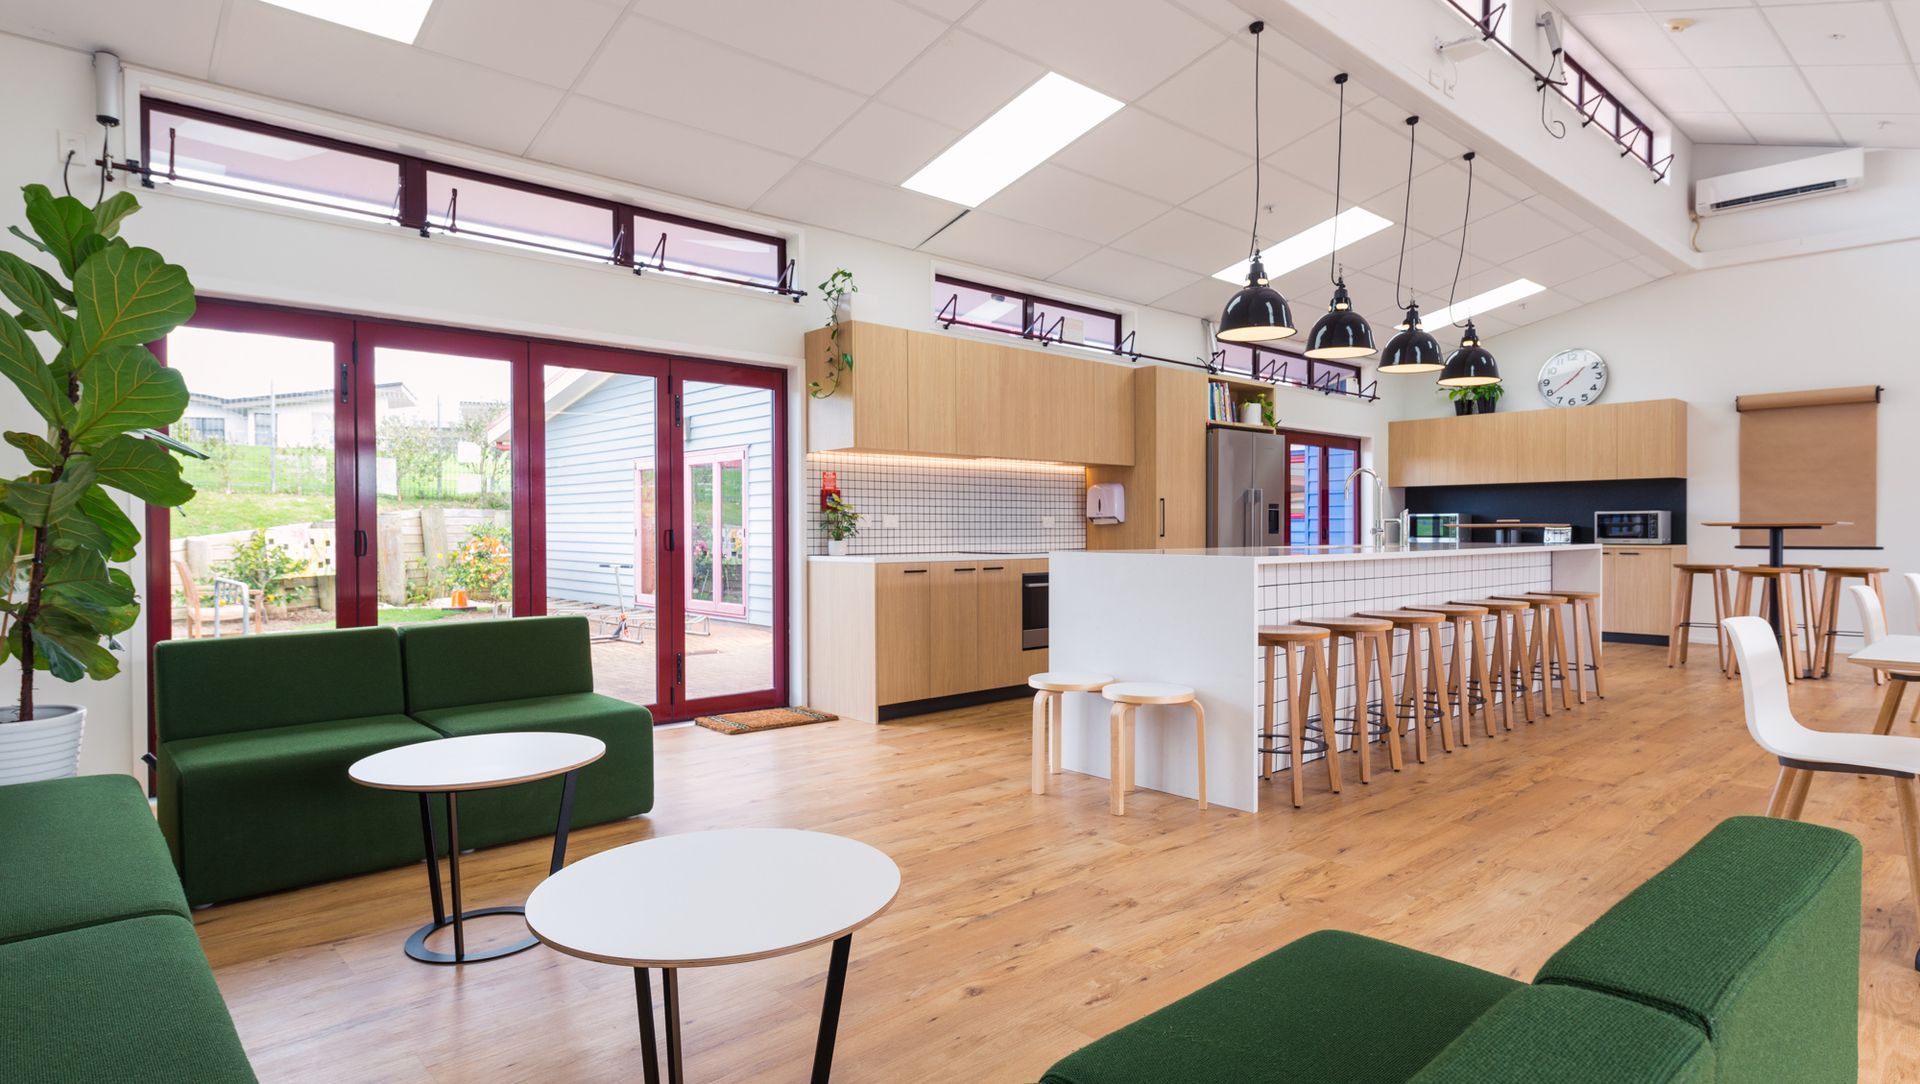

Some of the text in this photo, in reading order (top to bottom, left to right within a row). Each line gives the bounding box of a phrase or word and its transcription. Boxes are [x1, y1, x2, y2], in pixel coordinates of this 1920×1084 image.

[1568, 353, 1577, 361] 12
[1591, 361, 1600, 370] 2
[1547, 367, 1557, 375] 10
[1595, 371, 1603, 380] 3
[1542, 379, 1551, 387] 9
[1589, 383, 1597, 391] 4
[1546, 389, 1554, 397] 8
[1581, 393, 1589, 401] 5
[1556, 396, 1564, 404] 7
[1568, 397, 1576, 406] 6
